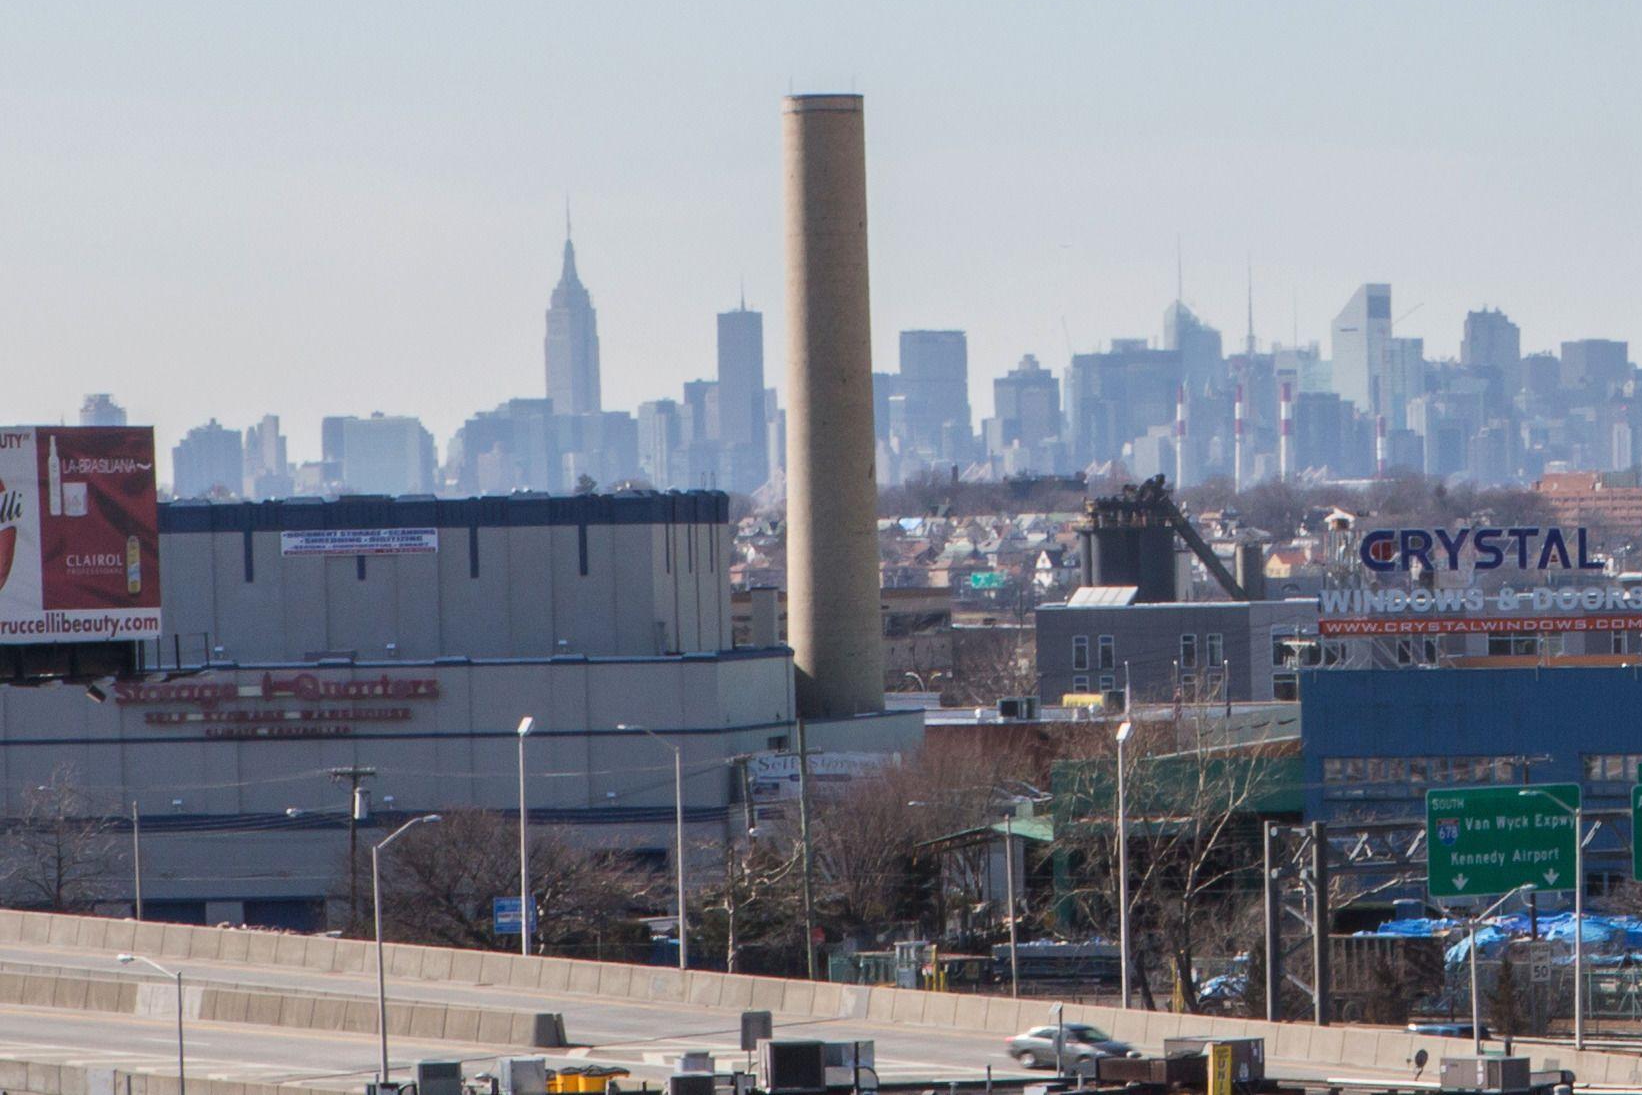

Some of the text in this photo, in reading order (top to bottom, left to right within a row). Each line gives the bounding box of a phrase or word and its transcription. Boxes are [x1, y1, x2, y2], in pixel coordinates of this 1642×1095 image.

[1359, 527, 1606, 572] CRYSTAL
[66, 554, 123, 567] CLAIROL
[1319, 587, 1485, 613] WINDOWS
[1499, 587, 1521, 611] &
[1326, 617, 1642, 634] WWW.CRYSTALWINDOWS.COM
[1432, 798, 1465, 811] SOUTH
[1465, 816, 1491, 831] Van
[1496, 815, 1529, 832] Wyck
[1535, 813, 1575, 830] Expwy
[1438, 826, 1459, 840] 678
[1450, 847, 1560, 867] Kennedy Airport
[1534, 965, 1549, 978] 50
